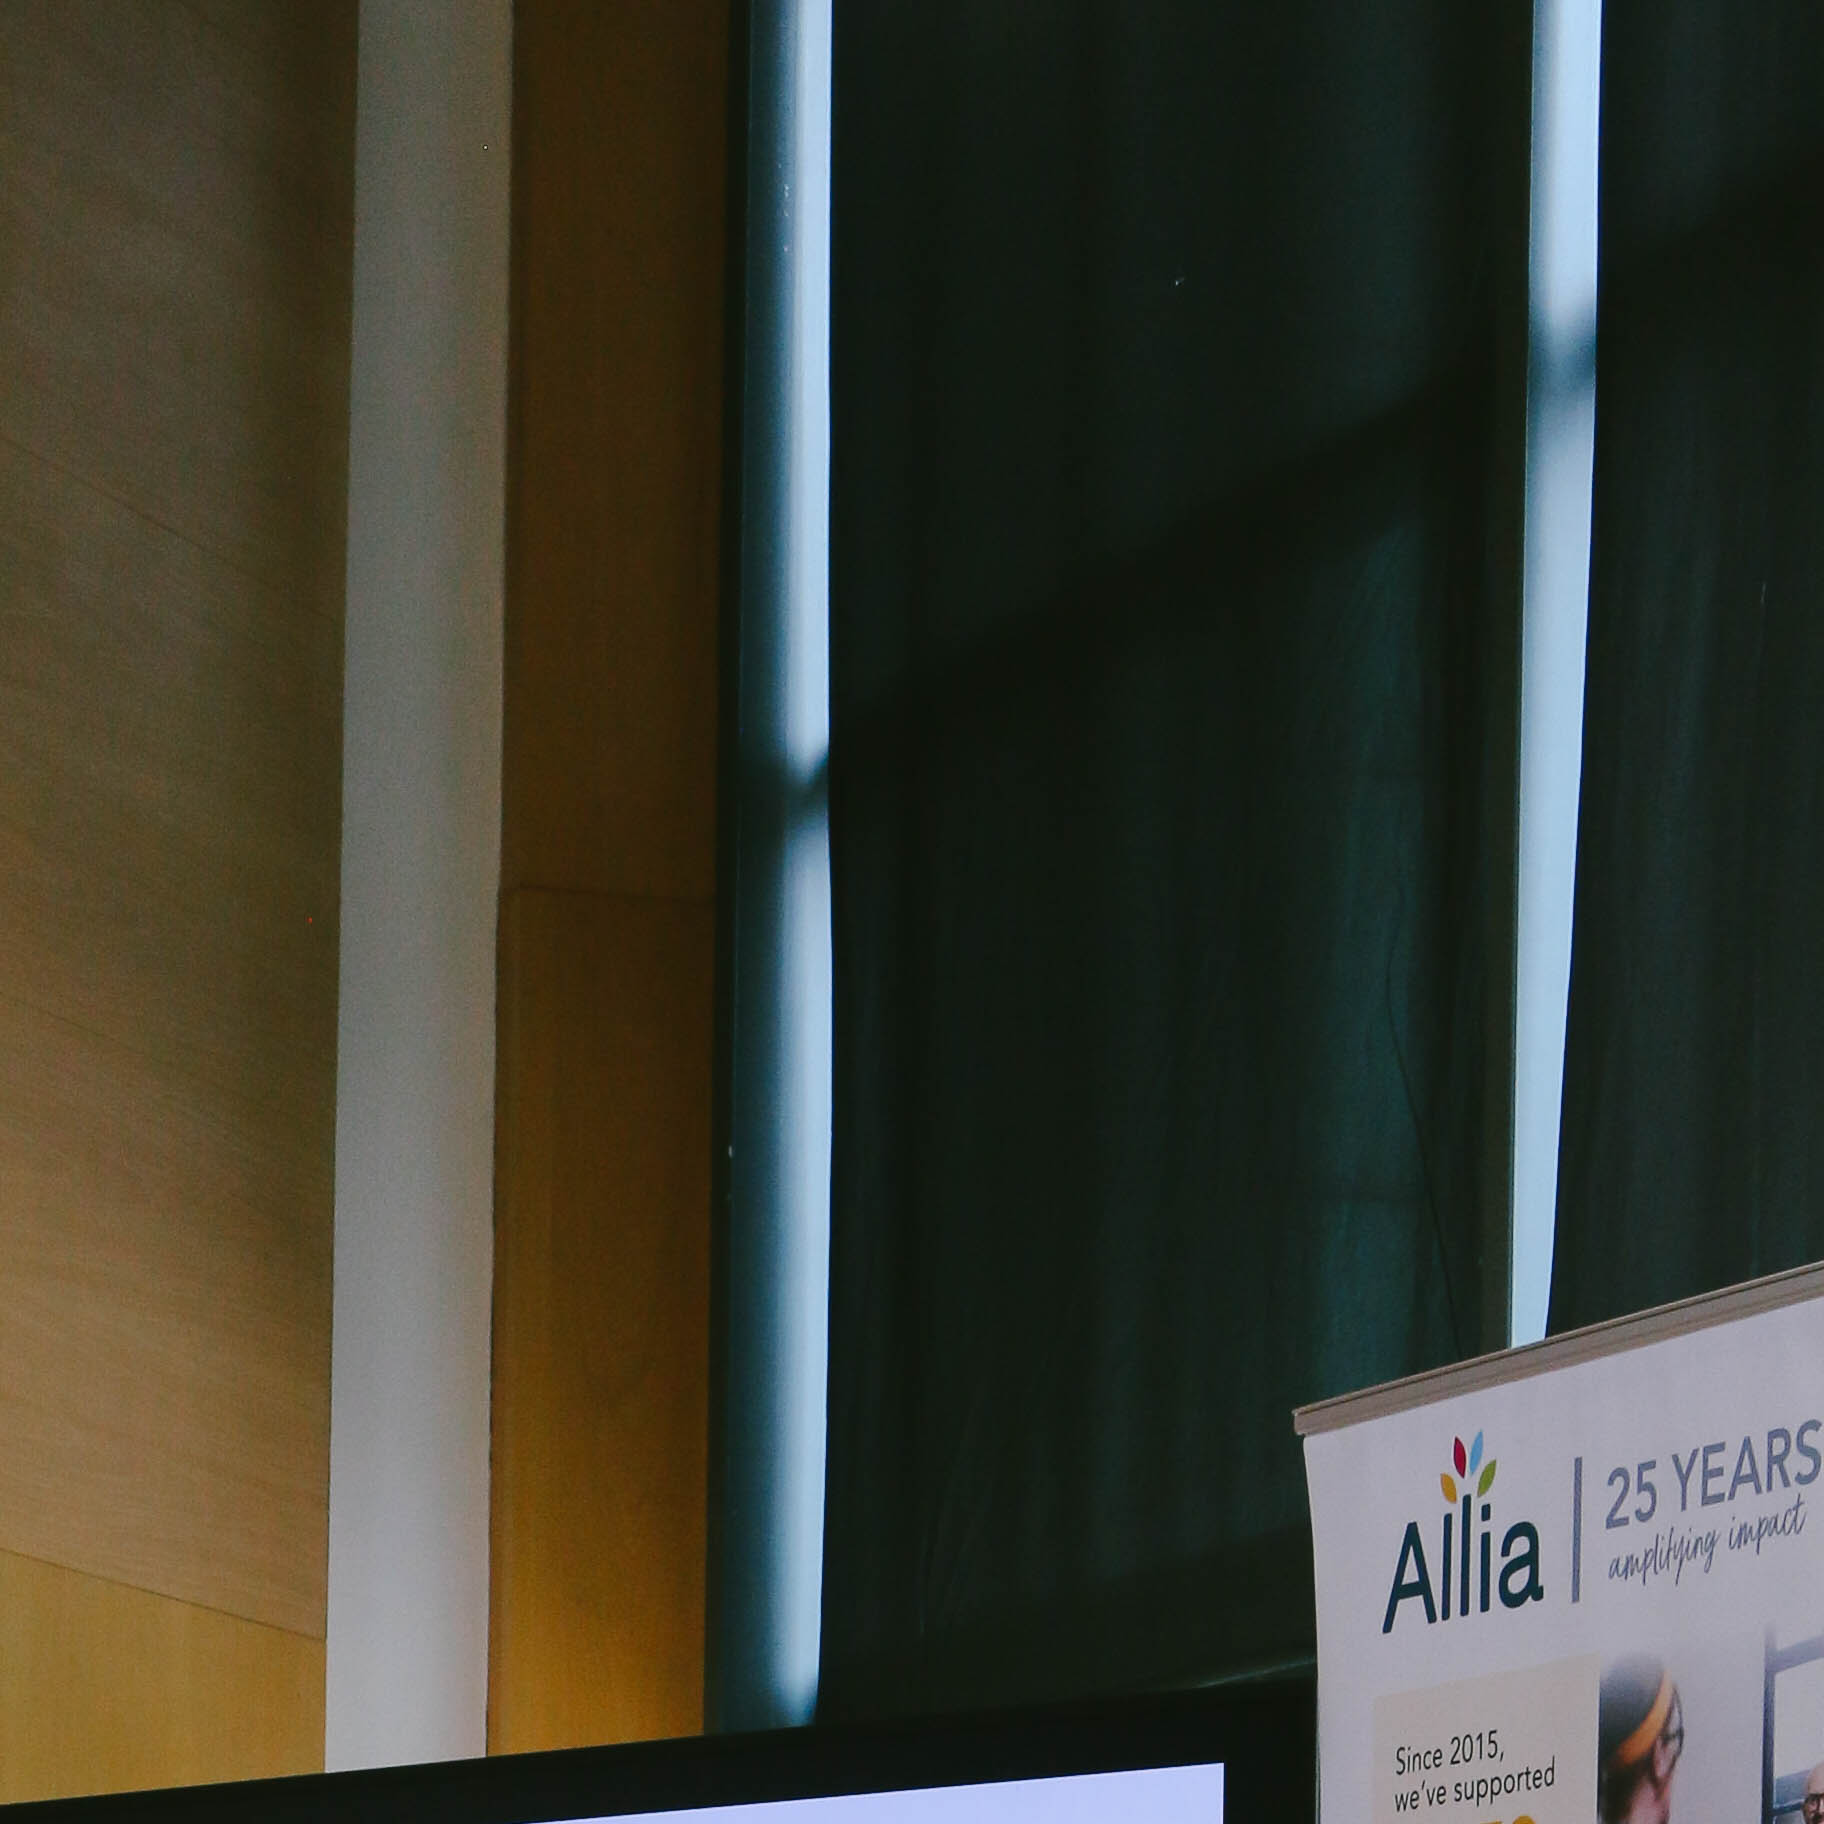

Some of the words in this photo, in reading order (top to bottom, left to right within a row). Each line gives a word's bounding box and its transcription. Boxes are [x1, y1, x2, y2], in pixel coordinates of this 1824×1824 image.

[1605, 1460, 1657, 1530] 25
[1671, 1419, 1823, 1513] YEARS
[1382, 1493, 1545, 1635] Allia
[1608, 1526, 1722, 1587] amplifying
[1728, 1493, 1808, 1555] impact
[1394, 1780, 1447, 1813] we've
[1454, 1754, 1556, 1807] supported
[1395, 1746, 1444, 1776] Since
[1450, 1729, 1505, 1766] 2015,
